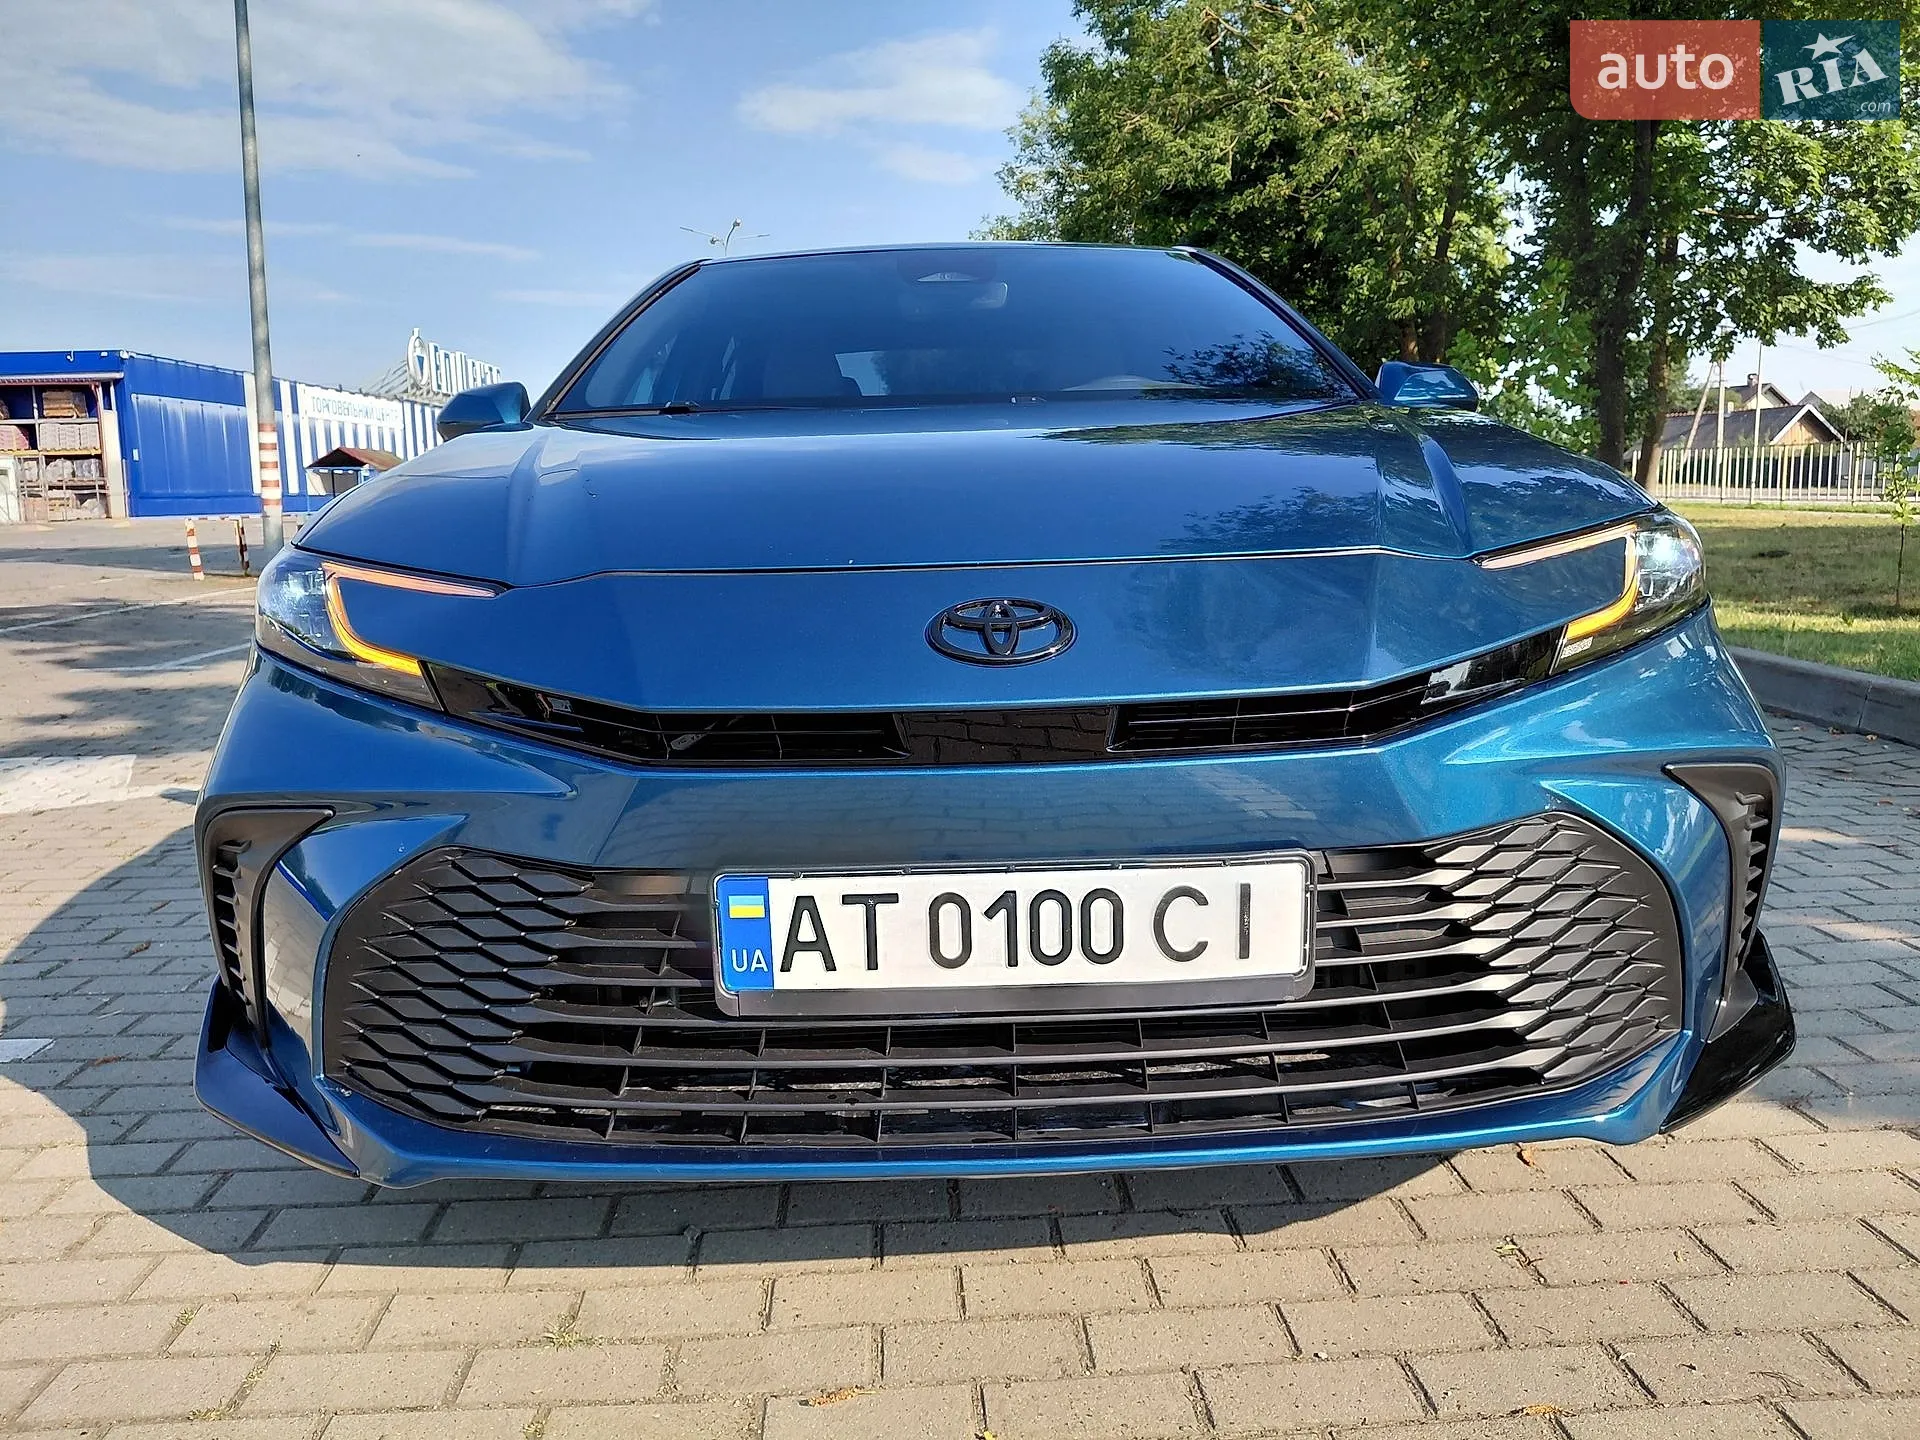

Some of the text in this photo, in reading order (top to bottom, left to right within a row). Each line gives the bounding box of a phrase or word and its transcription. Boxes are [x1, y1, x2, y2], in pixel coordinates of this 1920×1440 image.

[780, 881, 1251, 973] AT 0100 CI
[731, 947, 769, 974] UA
